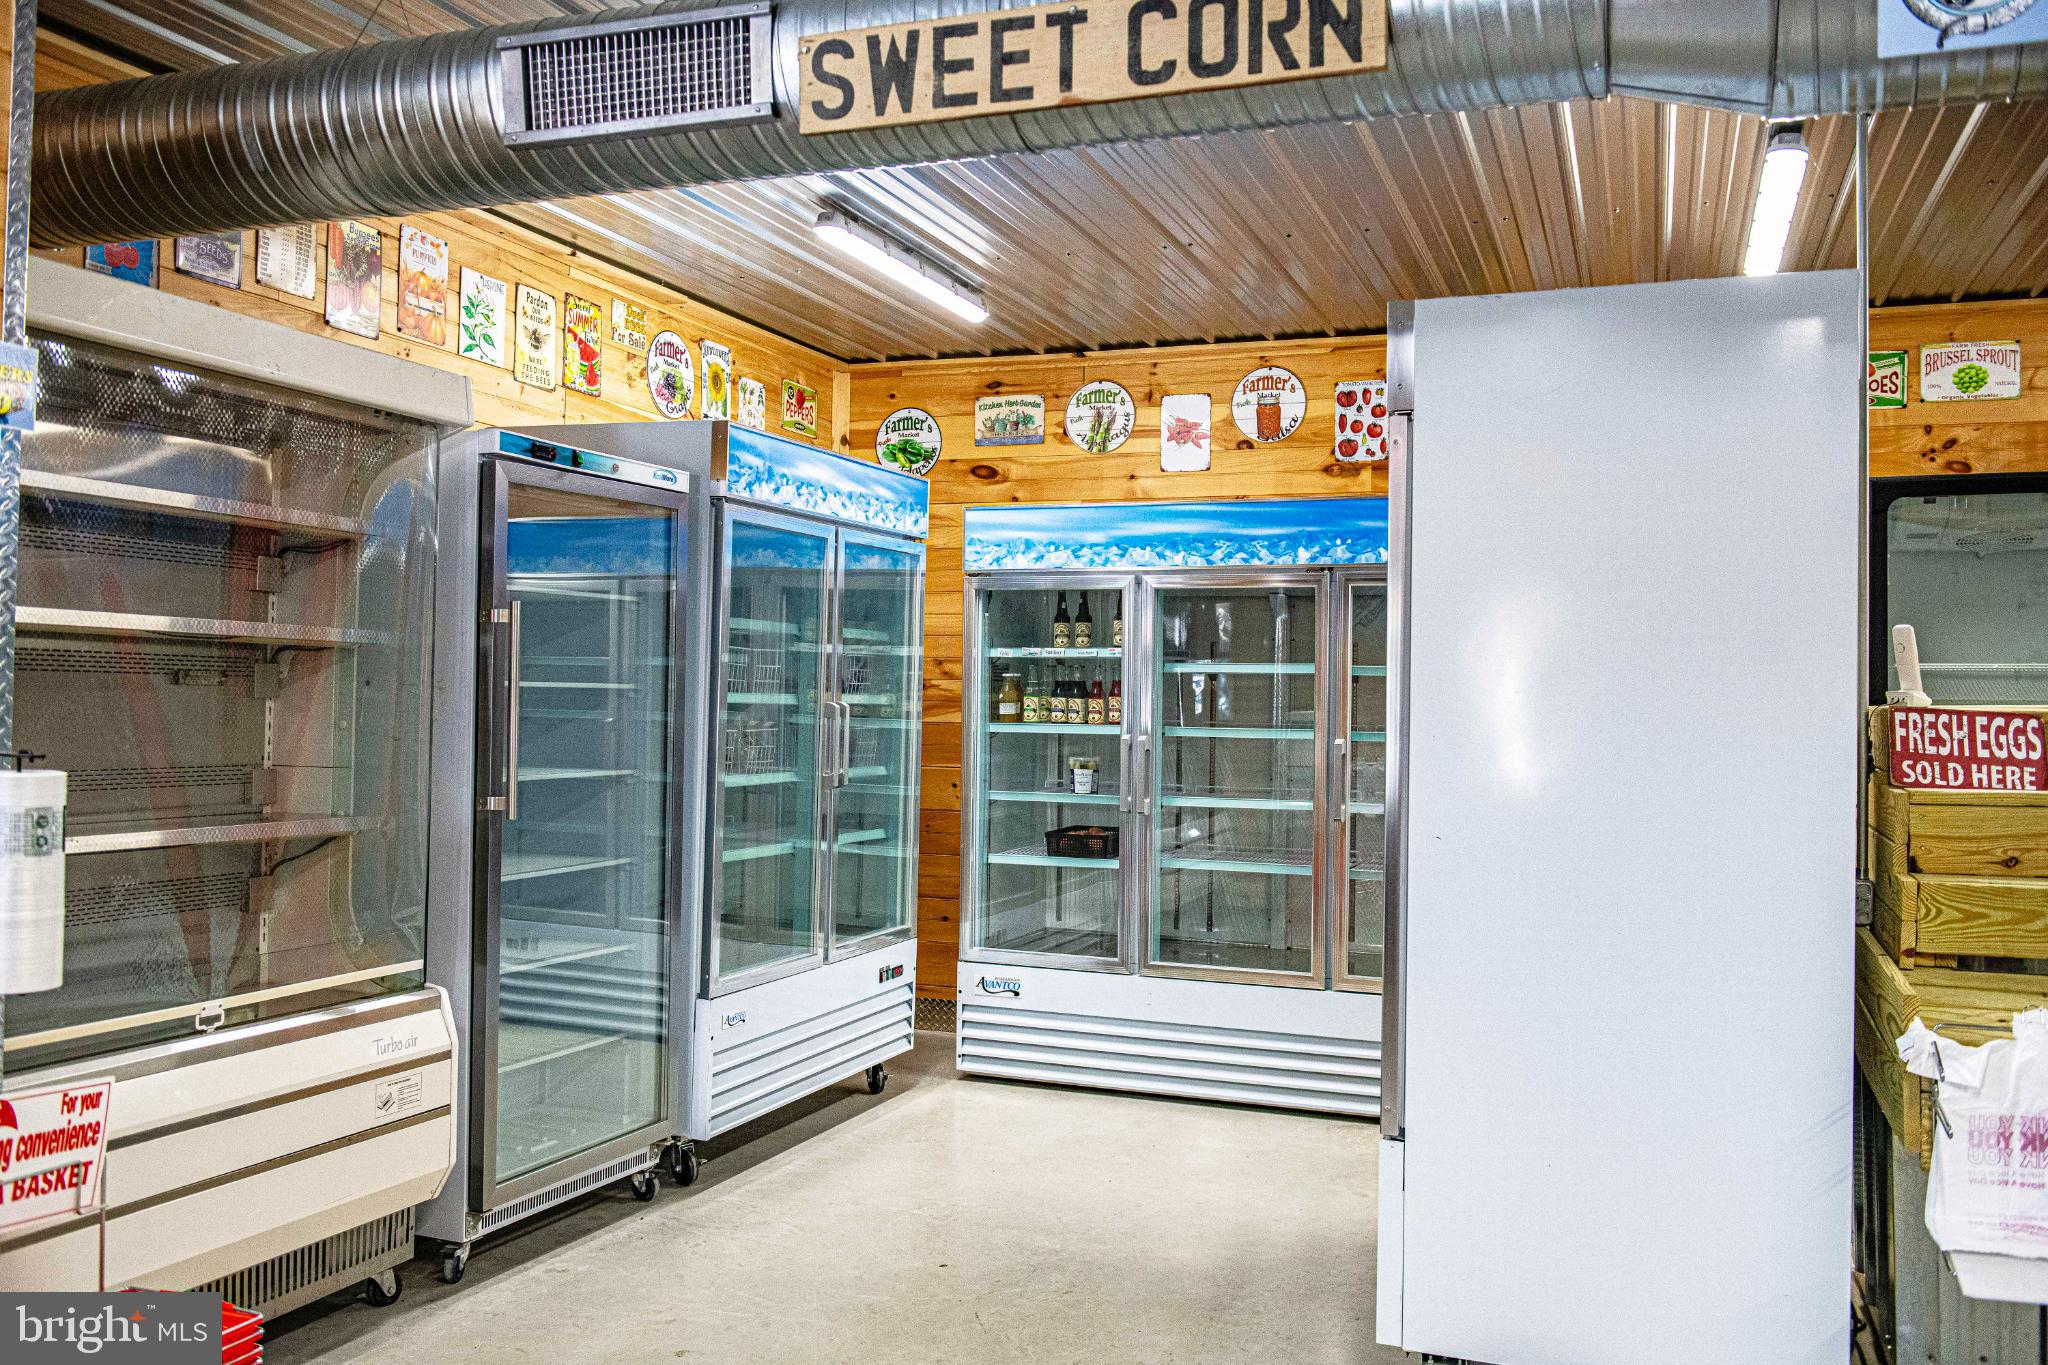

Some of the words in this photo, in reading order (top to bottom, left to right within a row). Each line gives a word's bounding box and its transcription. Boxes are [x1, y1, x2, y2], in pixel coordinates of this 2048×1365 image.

[810, 9, 1088, 121] SWEET
[1127, 0, 1364, 86] CORN
[526, 291, 549, 311] Pardon
[568, 308, 598, 334] SUMMER
[628, 332, 646, 350] Sale
[655, 339, 689, 368] Farmer's
[522, 363, 550, 377] FEEDING
[1924, 349, 1974, 377] BRUSSEL
[1975, 348, 2019, 372] SPROUT
[521, 371, 534, 382] THE
[535, 375, 551, 386] BEES
[1241, 374, 1296, 395] Farmer's
[1868, 370, 1900, 395] OES
[978, 402, 1004, 412] Kitchen
[1004, 399, 1020, 409] Herb
[1020, 399, 1042, 410] Garden
[1075, 388, 1126, 408] Farmer's
[785, 399, 814, 426] PEPPERS
[884, 416, 933, 436] Farmer's
[1894, 711, 1970, 757] FRESH
[1975, 716, 2042, 761] EGGS
[1901, 759, 1965, 787] SOLD
[1970, 763, 2037, 791] HERE
[976, 976, 1021, 993] AVANTCO
[371, 1036, 403, 1056] Turbo
[404, 1032, 419, 1050] air
[61, 1091, 80, 1116] For
[80, 1090, 103, 1115] your
[15, 1119, 100, 1162] convenience
[11, 1160, 94, 1202] BASKET
